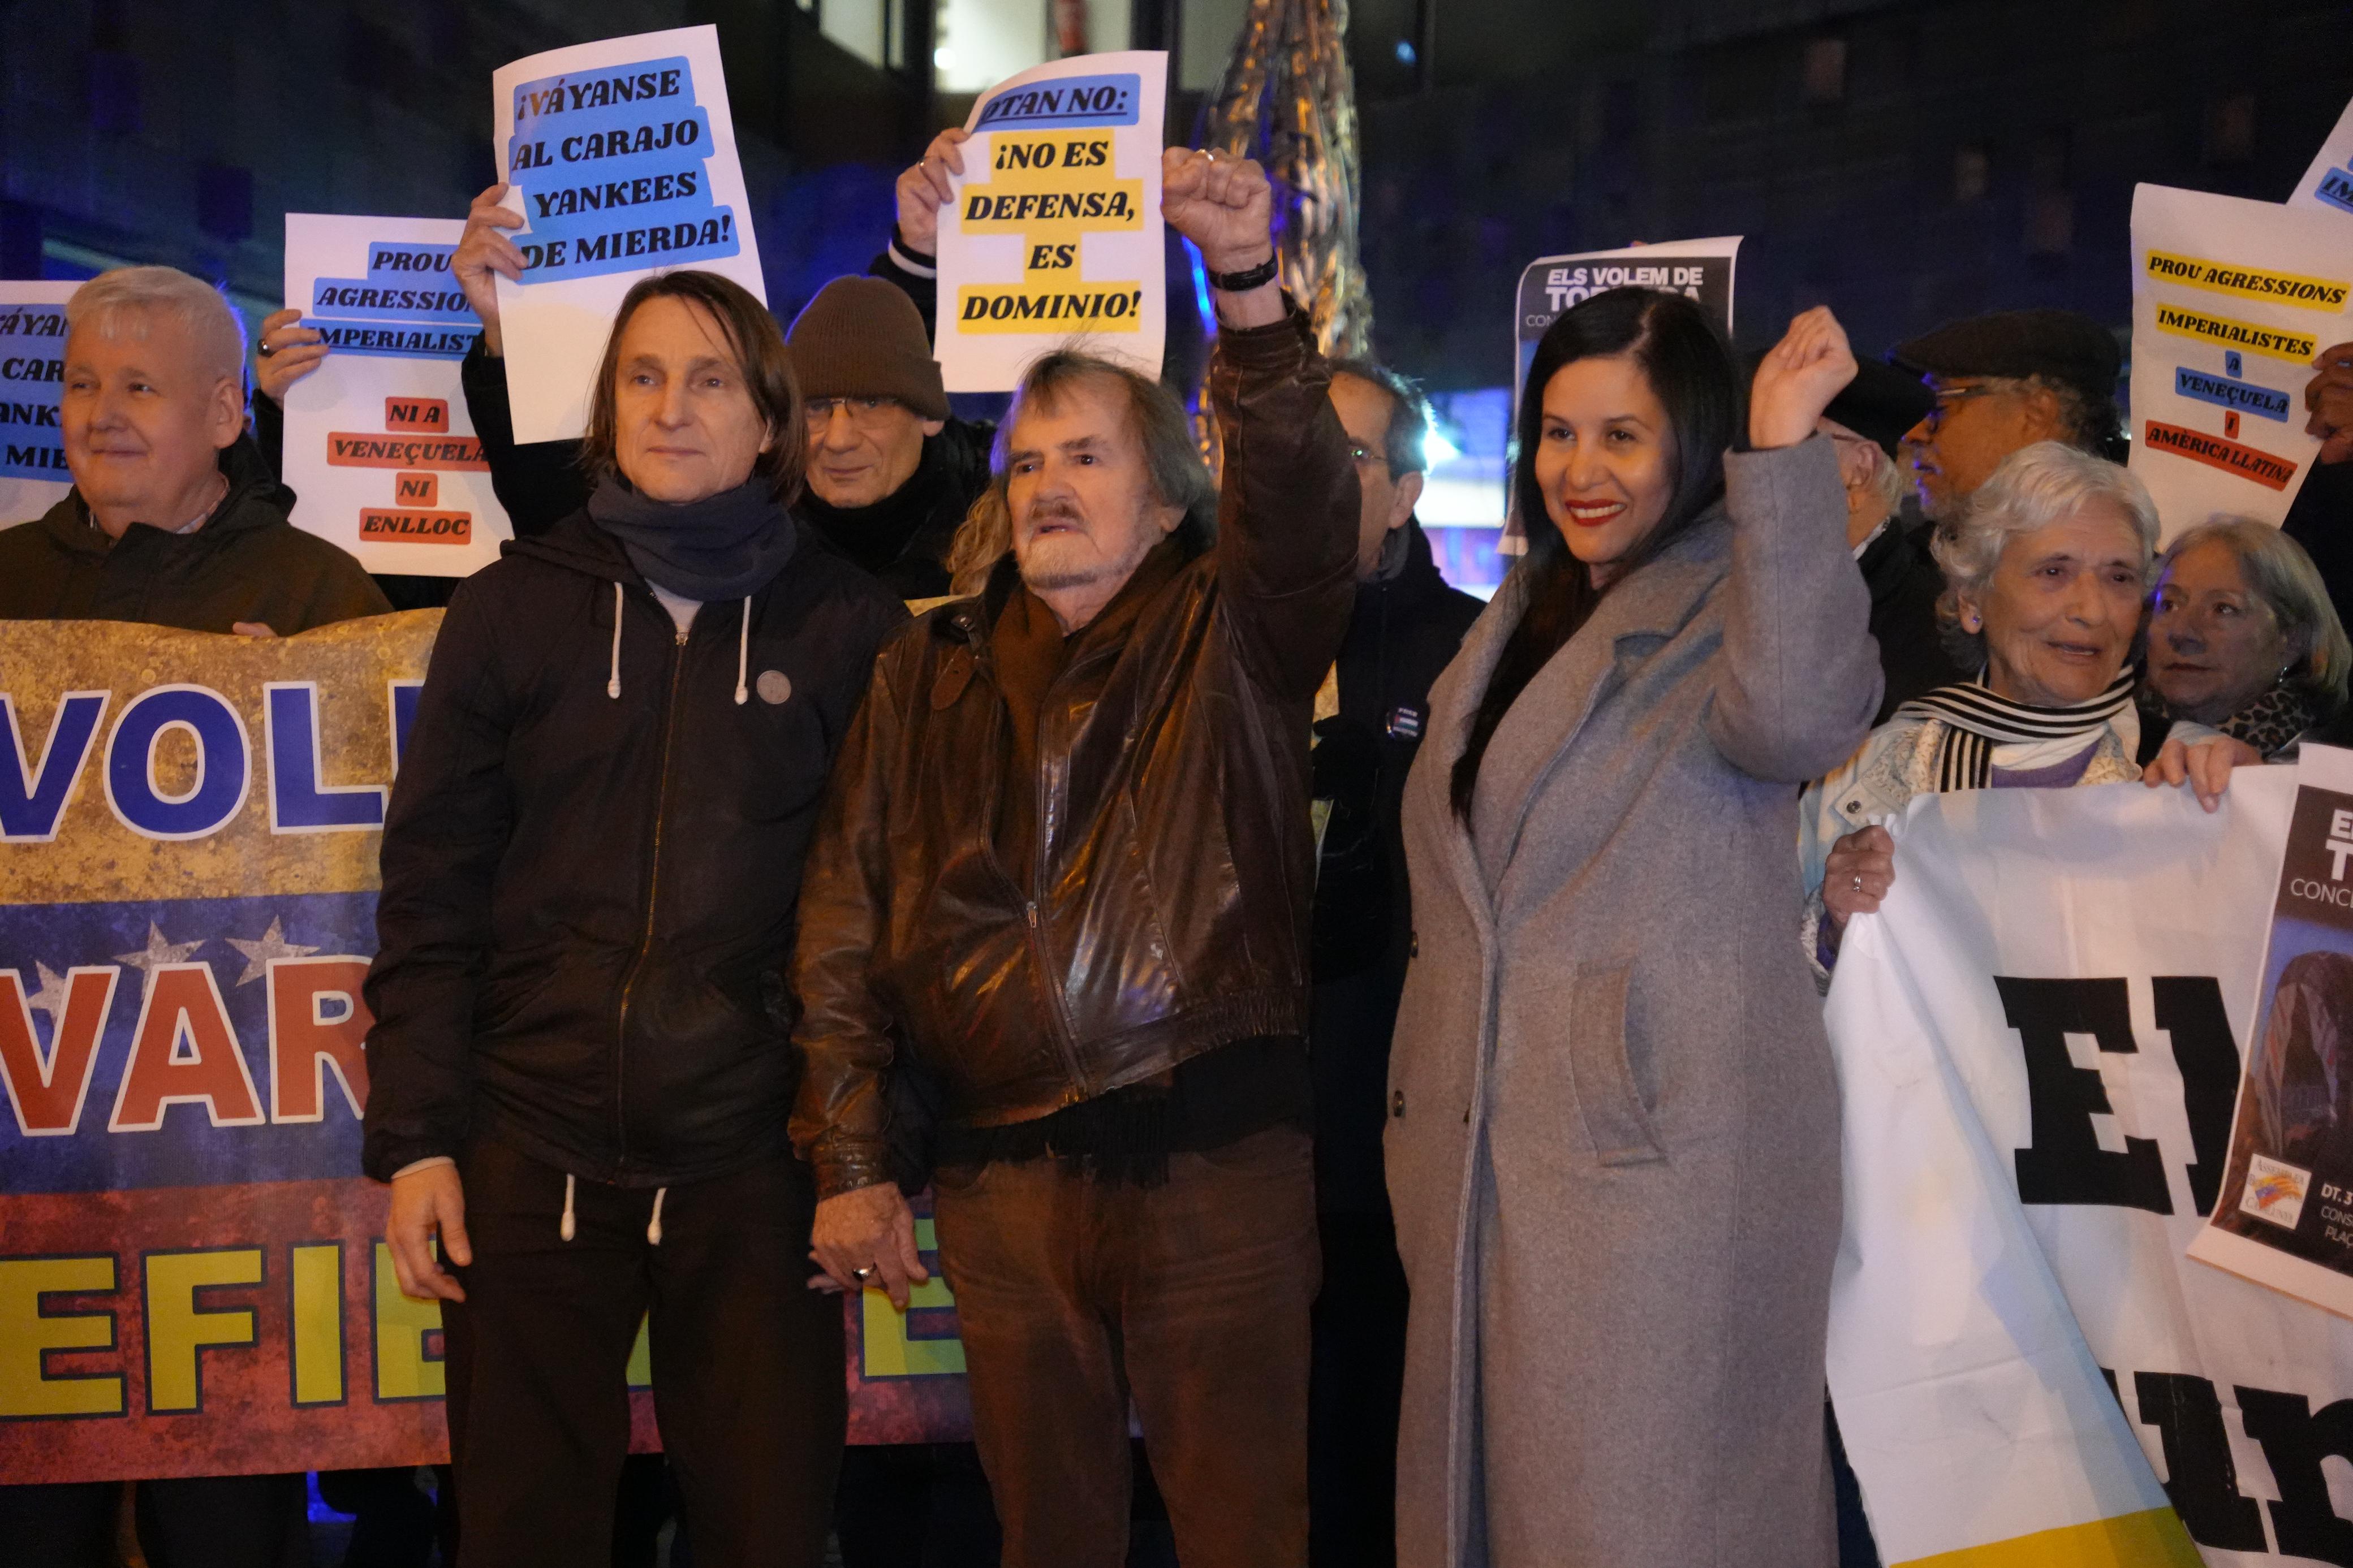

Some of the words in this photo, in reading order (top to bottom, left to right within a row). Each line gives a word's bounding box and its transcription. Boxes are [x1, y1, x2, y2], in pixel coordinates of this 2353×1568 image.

[517, 69, 681, 120] ¡VÁYANSE
[1067, 86, 1128, 113] NO:
[511, 141, 553, 171] AL
[561, 119, 700, 163] CARAJO
[995, 143, 1056, 170] ¡NO
[1061, 140, 1109, 167] ES
[532, 171, 697, 218] YANKEES
[964, 191, 1135, 222] DEFENSA,
[522, 240, 567, 271] DE
[575, 215, 731, 264] MIERDA!
[1028, 244, 1076, 270] ES
[372, 251, 454, 273] PROU
[1547, 267, 1589, 286] ELS
[1592, 266, 1669, 286] VOLEM
[1673, 266, 1704, 285] DE
[2149, 256, 2203, 279] PROU
[2203, 268, 2347, 304] AGRESSIONS
[316, 287, 473, 312] AGRESSIO
[961, 291, 1142, 321] DOMINIO!
[2158, 309, 2314, 356] IMPERIALISTES
[2229, 357, 2240, 371] A
[2180, 373, 2289, 414] VENEÇUELA
[389, 404, 419, 422] NI
[423, 406, 441, 423] A
[399, 480, 431, 498] NI
[363, 515, 469, 535] ENLLOC
[0, 679, 427, 843] VOL
[2291, 878, 2353, 909] CONC
